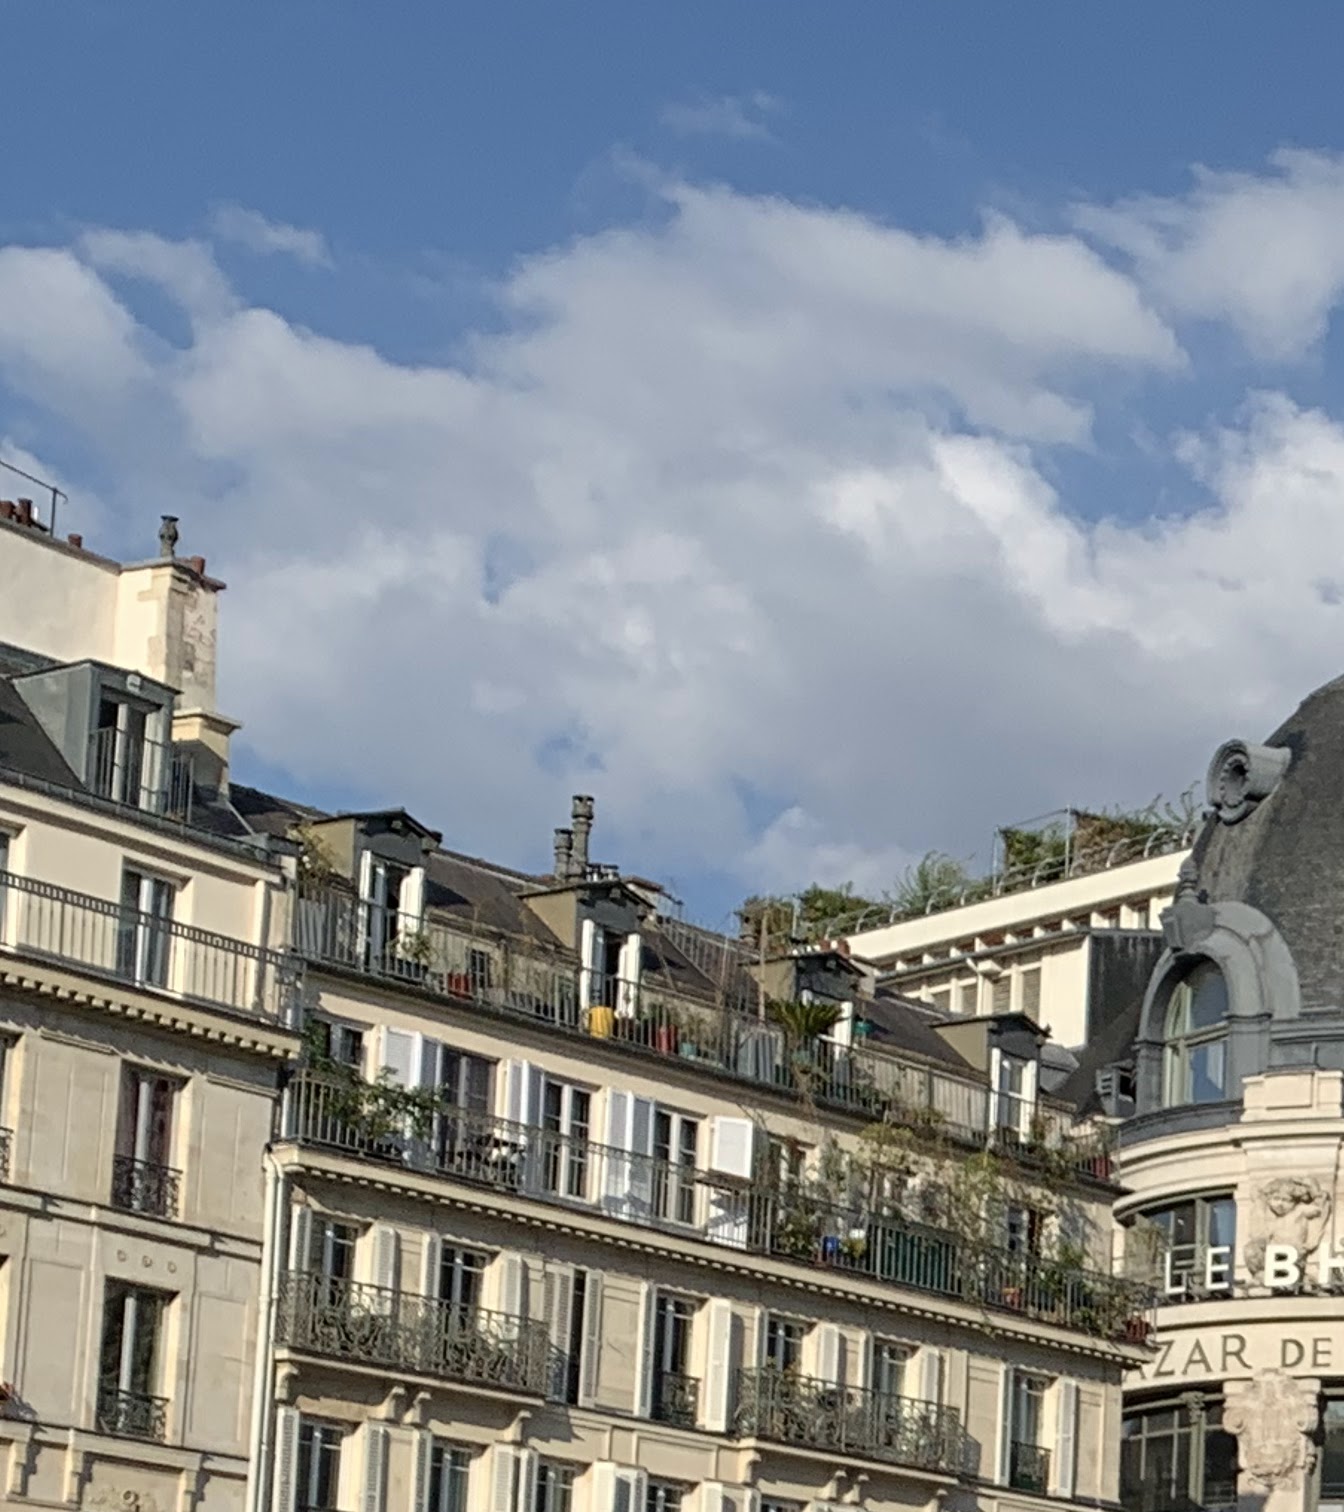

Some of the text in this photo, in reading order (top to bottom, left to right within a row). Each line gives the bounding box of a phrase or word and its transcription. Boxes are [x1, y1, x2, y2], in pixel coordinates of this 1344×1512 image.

[1164, 1246, 1231, 1295] LE
[1123, 1333, 1253, 1383] ZAR
[1280, 1337, 1333, 1369] DE
